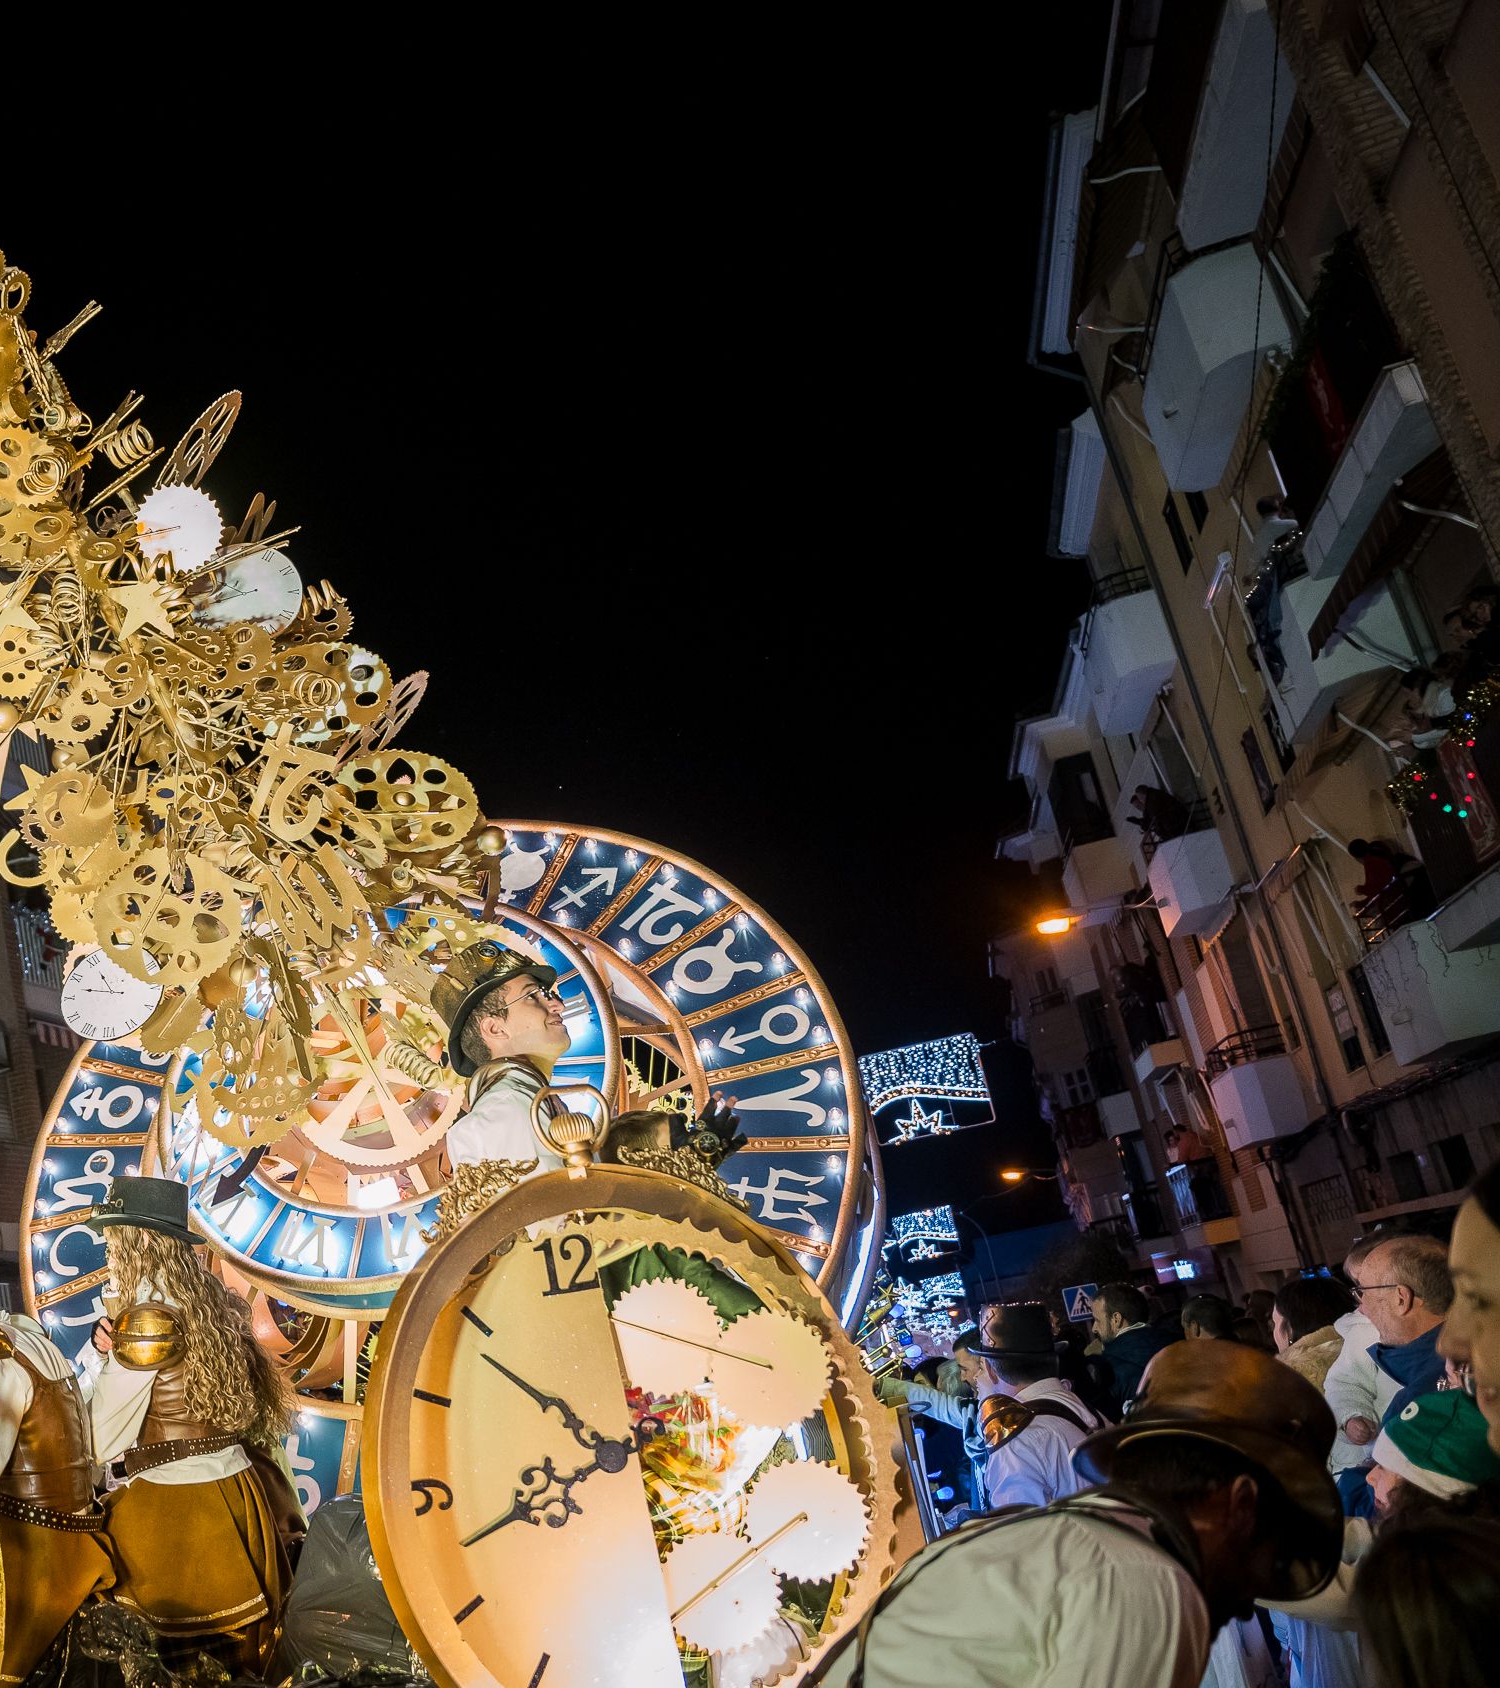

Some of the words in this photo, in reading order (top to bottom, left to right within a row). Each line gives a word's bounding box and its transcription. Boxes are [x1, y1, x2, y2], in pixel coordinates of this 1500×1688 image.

[262, 550, 275, 562] III
[279, 565, 295, 576] IV
[279, 609, 295, 620] VI
[86, 954, 100, 968] XII
[70, 972, 83, 983] XI
[67, 1011, 81, 1023] IX
[80, 1022, 97, 1037] VIII
[125, 1018, 137, 1030] VI
[102, 1026, 116, 1038] VII
[533, 1234, 601, 1297] 12
